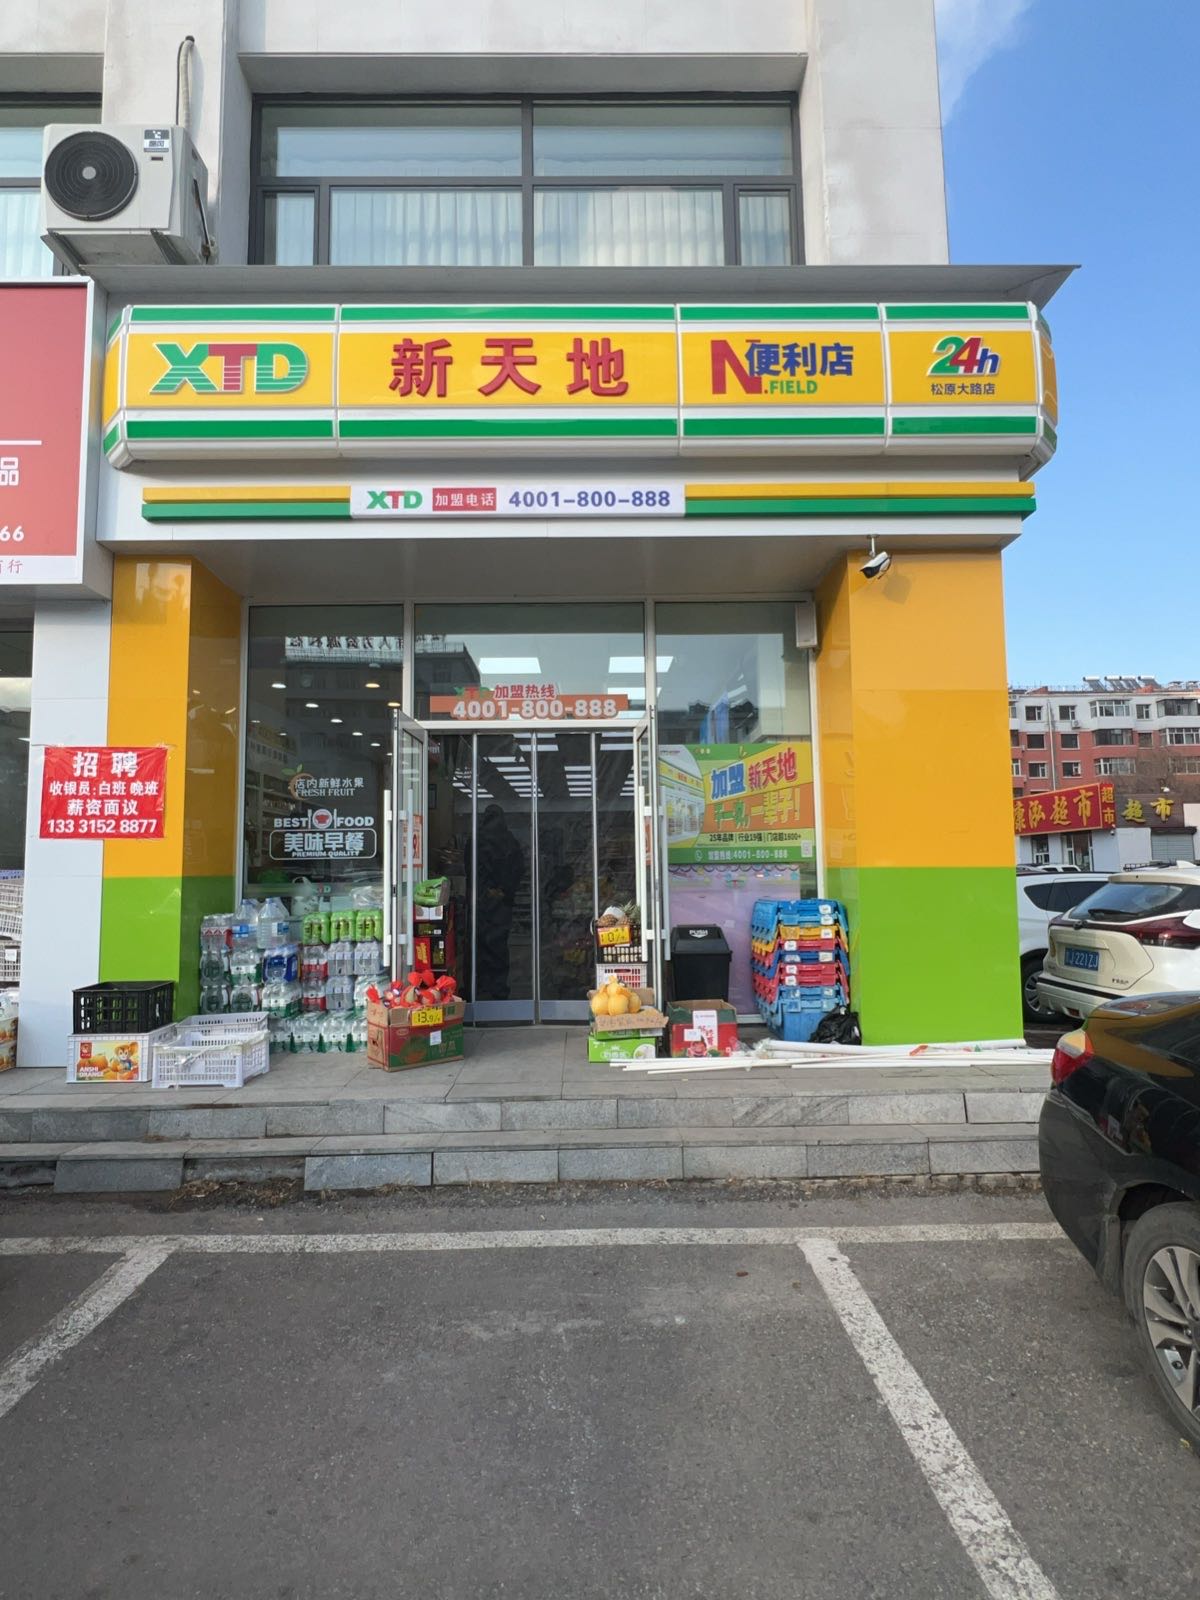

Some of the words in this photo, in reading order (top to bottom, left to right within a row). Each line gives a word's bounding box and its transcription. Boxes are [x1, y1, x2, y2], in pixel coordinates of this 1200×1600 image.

[745, 342, 854, 378] 便利店
[926, 336, 1001, 377] 24h
[150, 341, 310, 395] XTD
[390, 337, 628, 398] 新天地
[930, 382, 996, 396] 松原大路店
[366, 490, 423, 510] XTD
[434, 492, 495, 509] 加盟电话
[508, 489, 671, 508] 4001-800-888
[495, 684, 556, 699] 加盟热线
[453, 700, 617, 719] 4001-800-888
[72, 751, 139, 778] 招聘
[711, 762, 747, 800] 加盟
[748, 748, 798, 791] 新天地
[130, 780, 158, 796] 晚班
[295, 777, 364, 789] 店内新鲜水果
[296, 788, 326, 797] FRESH
[328, 788, 355, 797] FRUIT
[67, 799, 139, 817] 薪资面议
[1101, 786, 1115, 825] 超市
[1121, 797, 1175, 823] 超市
[48, 819, 75, 834] 133
[78, 819, 116, 834] 3152
[120, 819, 157, 834] 8877
[273, 817, 308, 828] BEST
[336, 816, 375, 828] FOOD
[284, 831, 365, 852] 美味早餐
